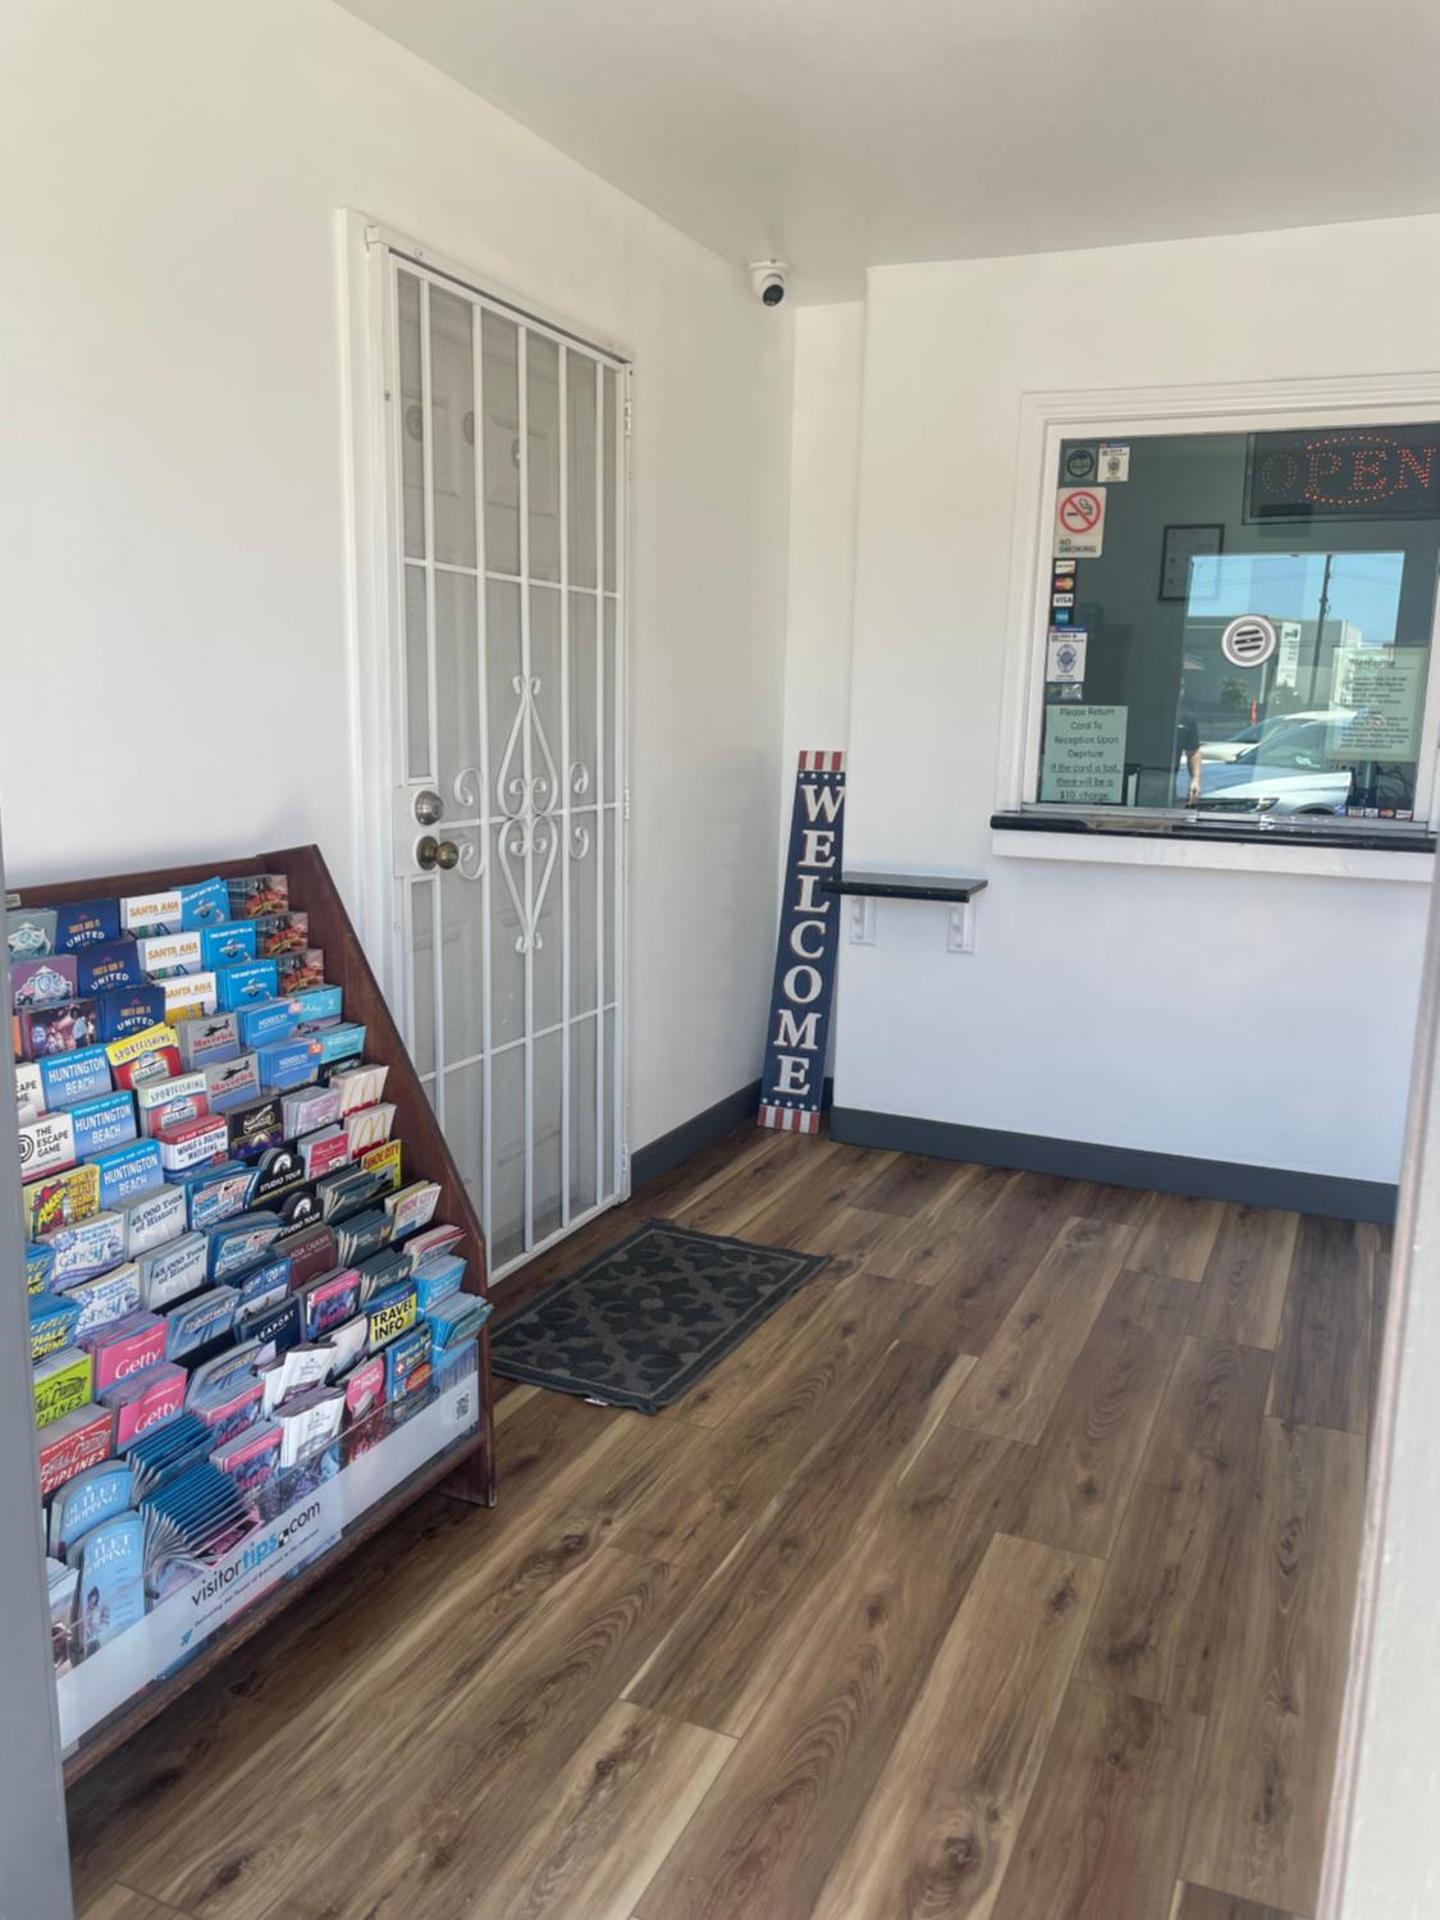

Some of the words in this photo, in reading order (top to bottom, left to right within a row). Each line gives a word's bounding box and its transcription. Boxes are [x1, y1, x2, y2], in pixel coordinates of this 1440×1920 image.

[1261, 448, 1437, 493] OPEN
[129, 903, 158, 918] SANTA
[160, 901, 179, 913] ANA
[66, 931, 105, 948] UNITED
[772, 784, 846, 1096] WELCOME
[148, 945, 177, 960] SANTA
[178, 942, 198, 954] ANA
[91, 973, 129, 991] UNITED
[193, 982, 212, 994] ANA
[117, 1017, 155, 1032] UNITED
[113, 1034, 170, 1060] SPORTFISHING
[49, 1056, 106, 1084] HUNTINGTON
[65, 1077, 95, 1096] BEACH
[150, 1080, 205, 1101] SPORTFISHING
[75, 1104, 132, 1132] HUNTINGTON
[36, 1125, 52, 1137] THE
[37, 1130, 69, 1148] ESCAPE
[92, 1125, 122, 1144] BEACH
[38, 1144, 61, 1158] GAME
[104, 1154, 158, 1184] HUNTINGTON
[119, 1176, 147, 1196] BEACH
[260, 1176, 284, 1193] STUDIO
[285, 1169, 301, 1184] TOUR
[372, 1299, 413, 1327] TRAVEL
[374, 1317, 404, 1341] INFO
[115, 1348, 161, 1380] Getty
[135, 1399, 179, 1434] Getty
[43, 1448, 105, 1494] ZIPLINES
